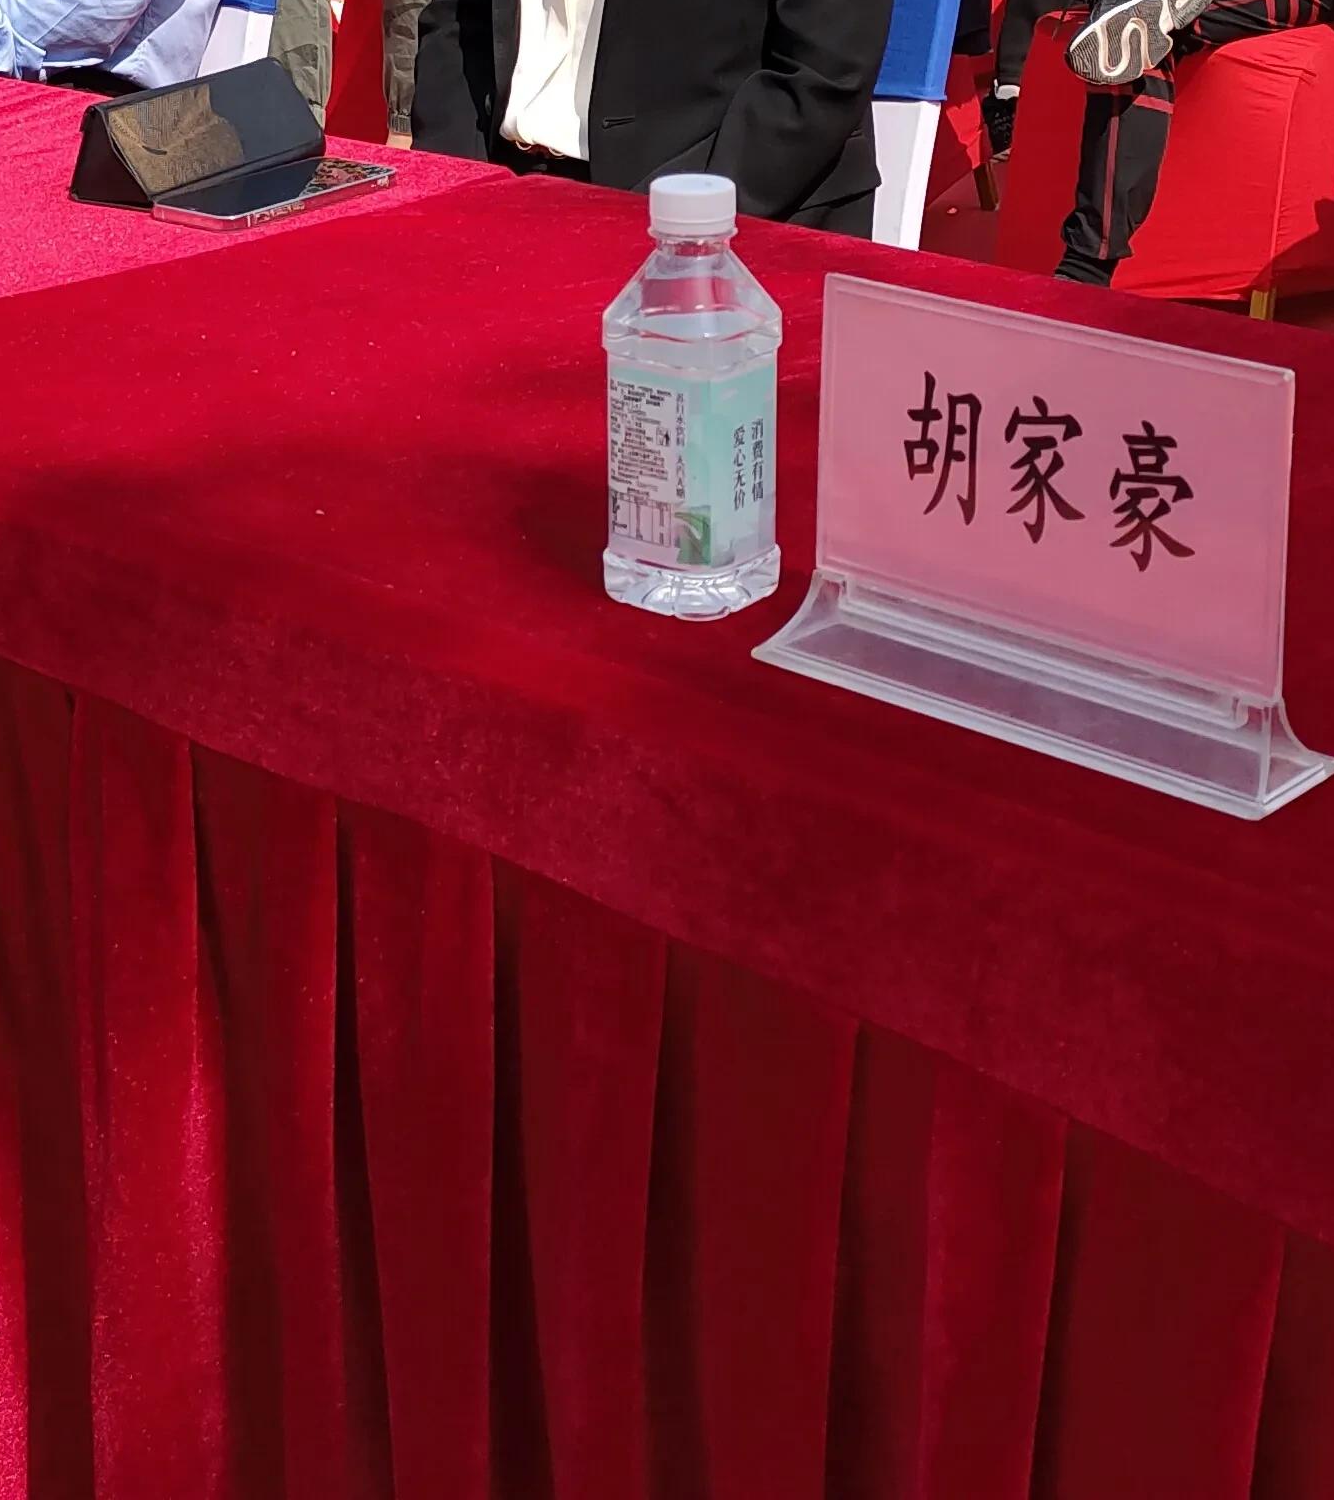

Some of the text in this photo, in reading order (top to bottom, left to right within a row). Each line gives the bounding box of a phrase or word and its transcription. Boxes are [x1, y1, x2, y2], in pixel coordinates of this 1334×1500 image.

[733, 426, 746, 511] 爱心无价
[751, 418, 764, 502] 消费有情
[902, 370, 1195, 571] 胡家豪
